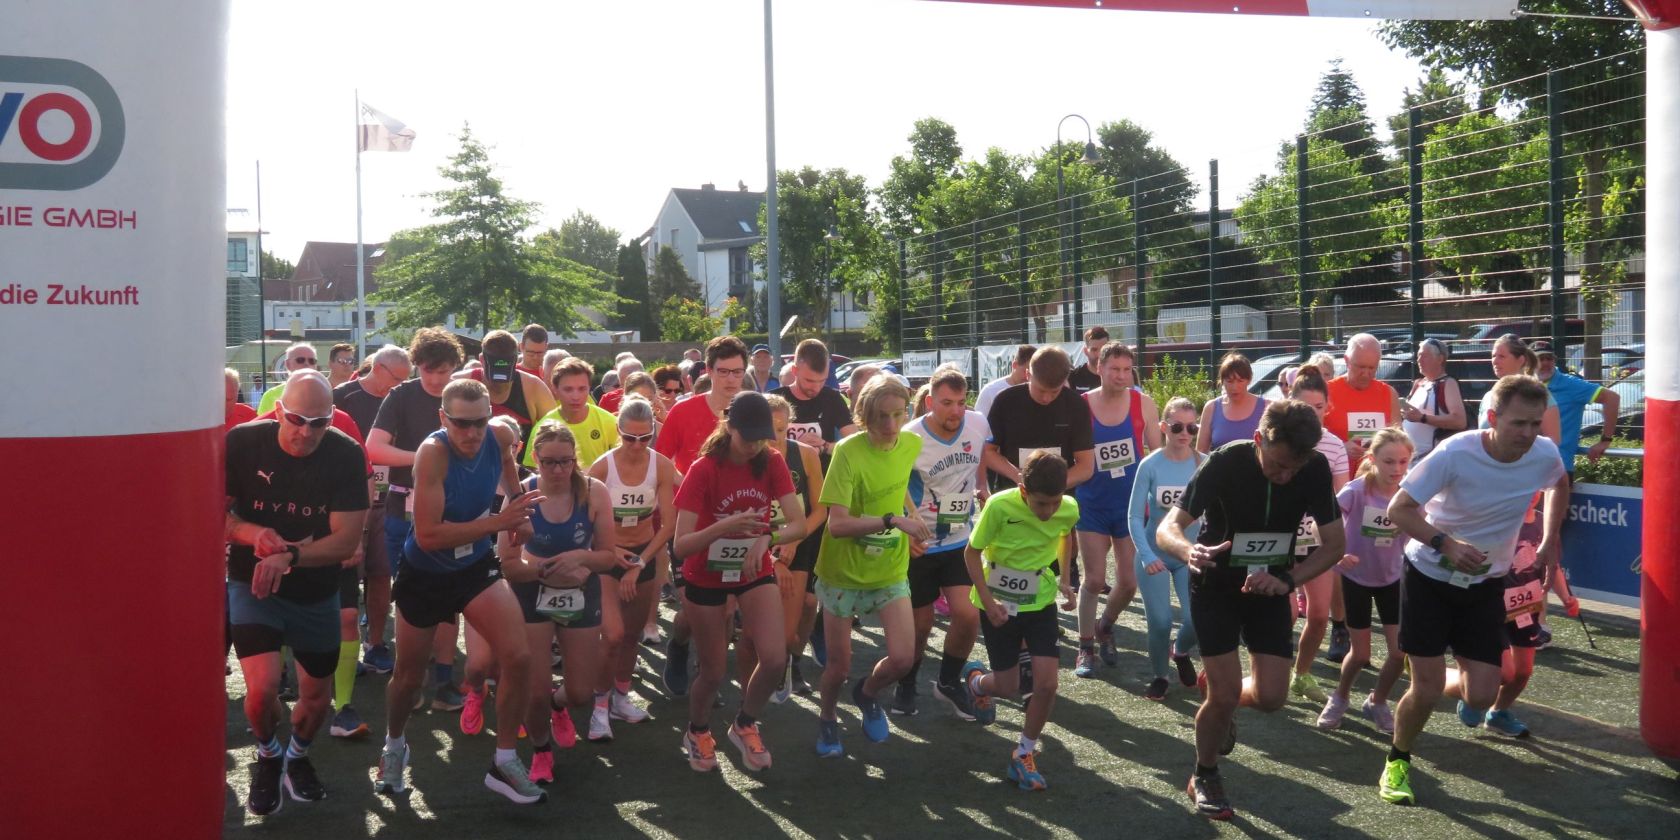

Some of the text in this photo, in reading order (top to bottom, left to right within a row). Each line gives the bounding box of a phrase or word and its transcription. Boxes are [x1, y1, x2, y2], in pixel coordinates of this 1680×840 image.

[0, 206, 137, 230] IE GMBH
[0, 284, 139, 306] die Zukunft
[1357, 419, 1376, 428] 521
[1100, 443, 1129, 460] 658
[929, 460, 945, 477] RUND
[943, 454, 955, 468] UM
[621, 494, 645, 505] 514
[1161, 490, 1182, 505] 65
[254, 500, 327, 517] HYROX
[950, 500, 968, 512] 537
[1568, 500, 1628, 527] scheck
[1373, 515, 1391, 527] 46
[720, 547, 748, 559] 522
[1246, 540, 1278, 552] 577
[999, 575, 1028, 591] 560
[548, 596, 573, 608] 451
[1510, 591, 1533, 607] 594
